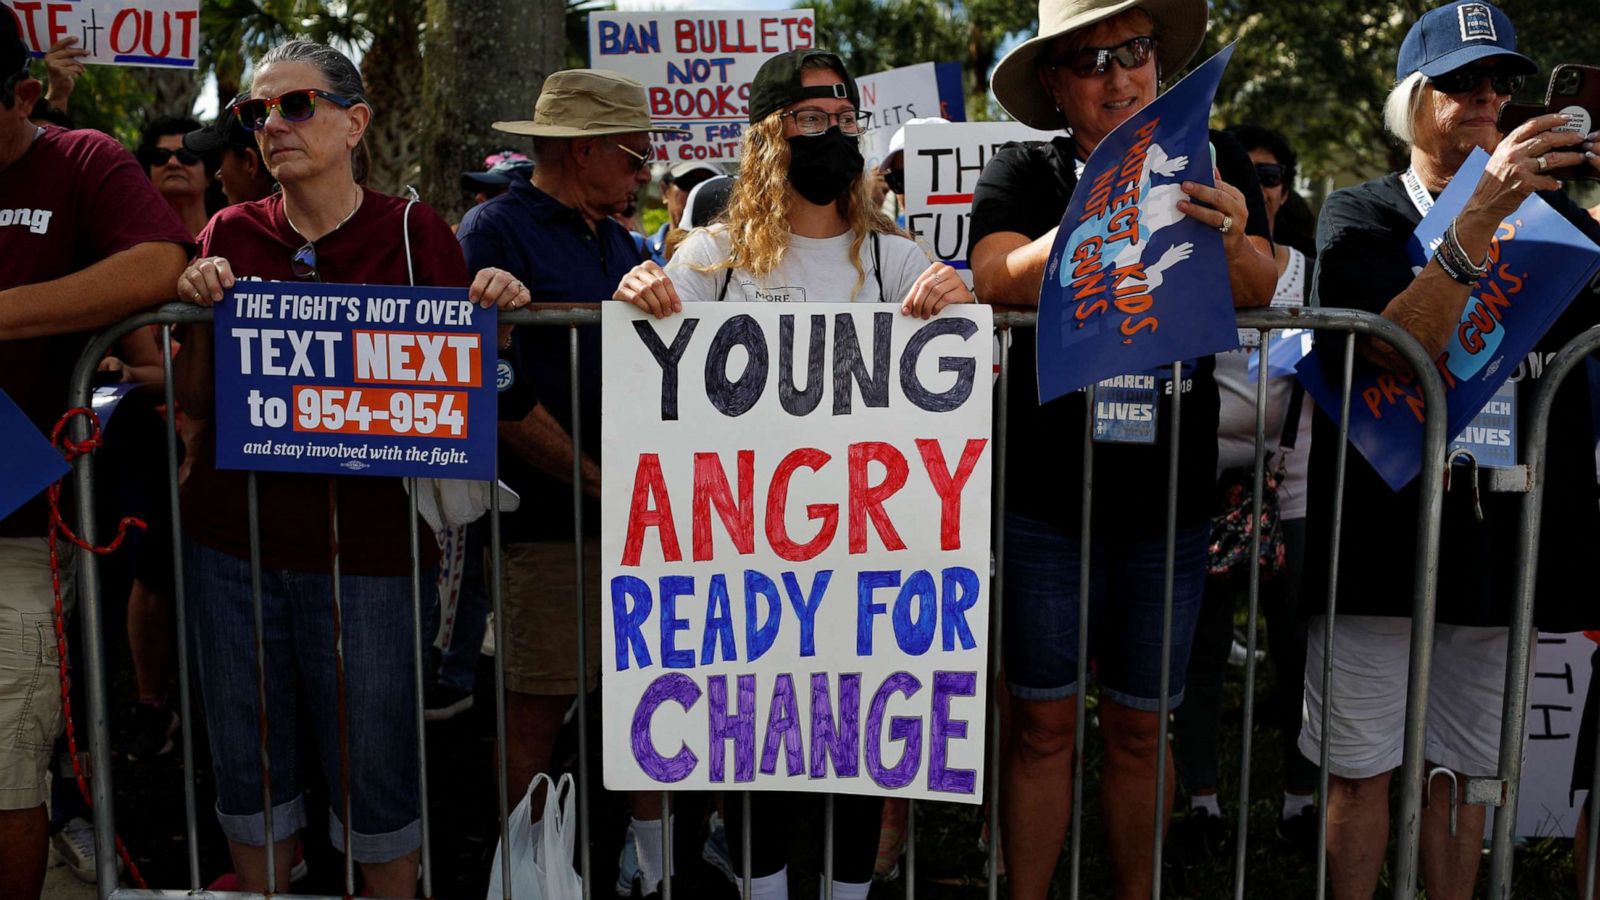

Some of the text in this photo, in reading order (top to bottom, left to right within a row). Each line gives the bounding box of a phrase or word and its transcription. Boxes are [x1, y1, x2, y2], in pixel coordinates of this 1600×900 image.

[81, 9, 104, 56] it
[110, 8, 197, 58] OUT
[598, 17, 813, 54] BAN BULLETS
[667, 57, 735, 84] NOT
[649, 82, 752, 116] BOOKS
[705, 123, 742, 142] FOR
[917, 144, 1002, 193] TH
[0, 208, 52, 234] ong
[909, 213, 972, 260] FU
[1106, 117, 1160, 345] PROTECT KIDS,
[1071, 164, 1119, 328] NOT GUNS.
[233, 293, 474, 326] THE FIGHT'S NOT OVER
[1458, 263, 1529, 355] GUNS.
[231, 328, 479, 383] TEXT NEXT
[631, 311, 979, 421] YOUNG
[1097, 401, 1153, 421] LIVES
[1165, 379, 1193, 395] 218
[247, 388, 464, 436] to 954-954
[243, 440, 469, 465] and stay involved with the fight.
[620, 438, 989, 567] ANGRY
[610, 567, 980, 672] READY FOR
[630, 670, 978, 795] CHANGE
